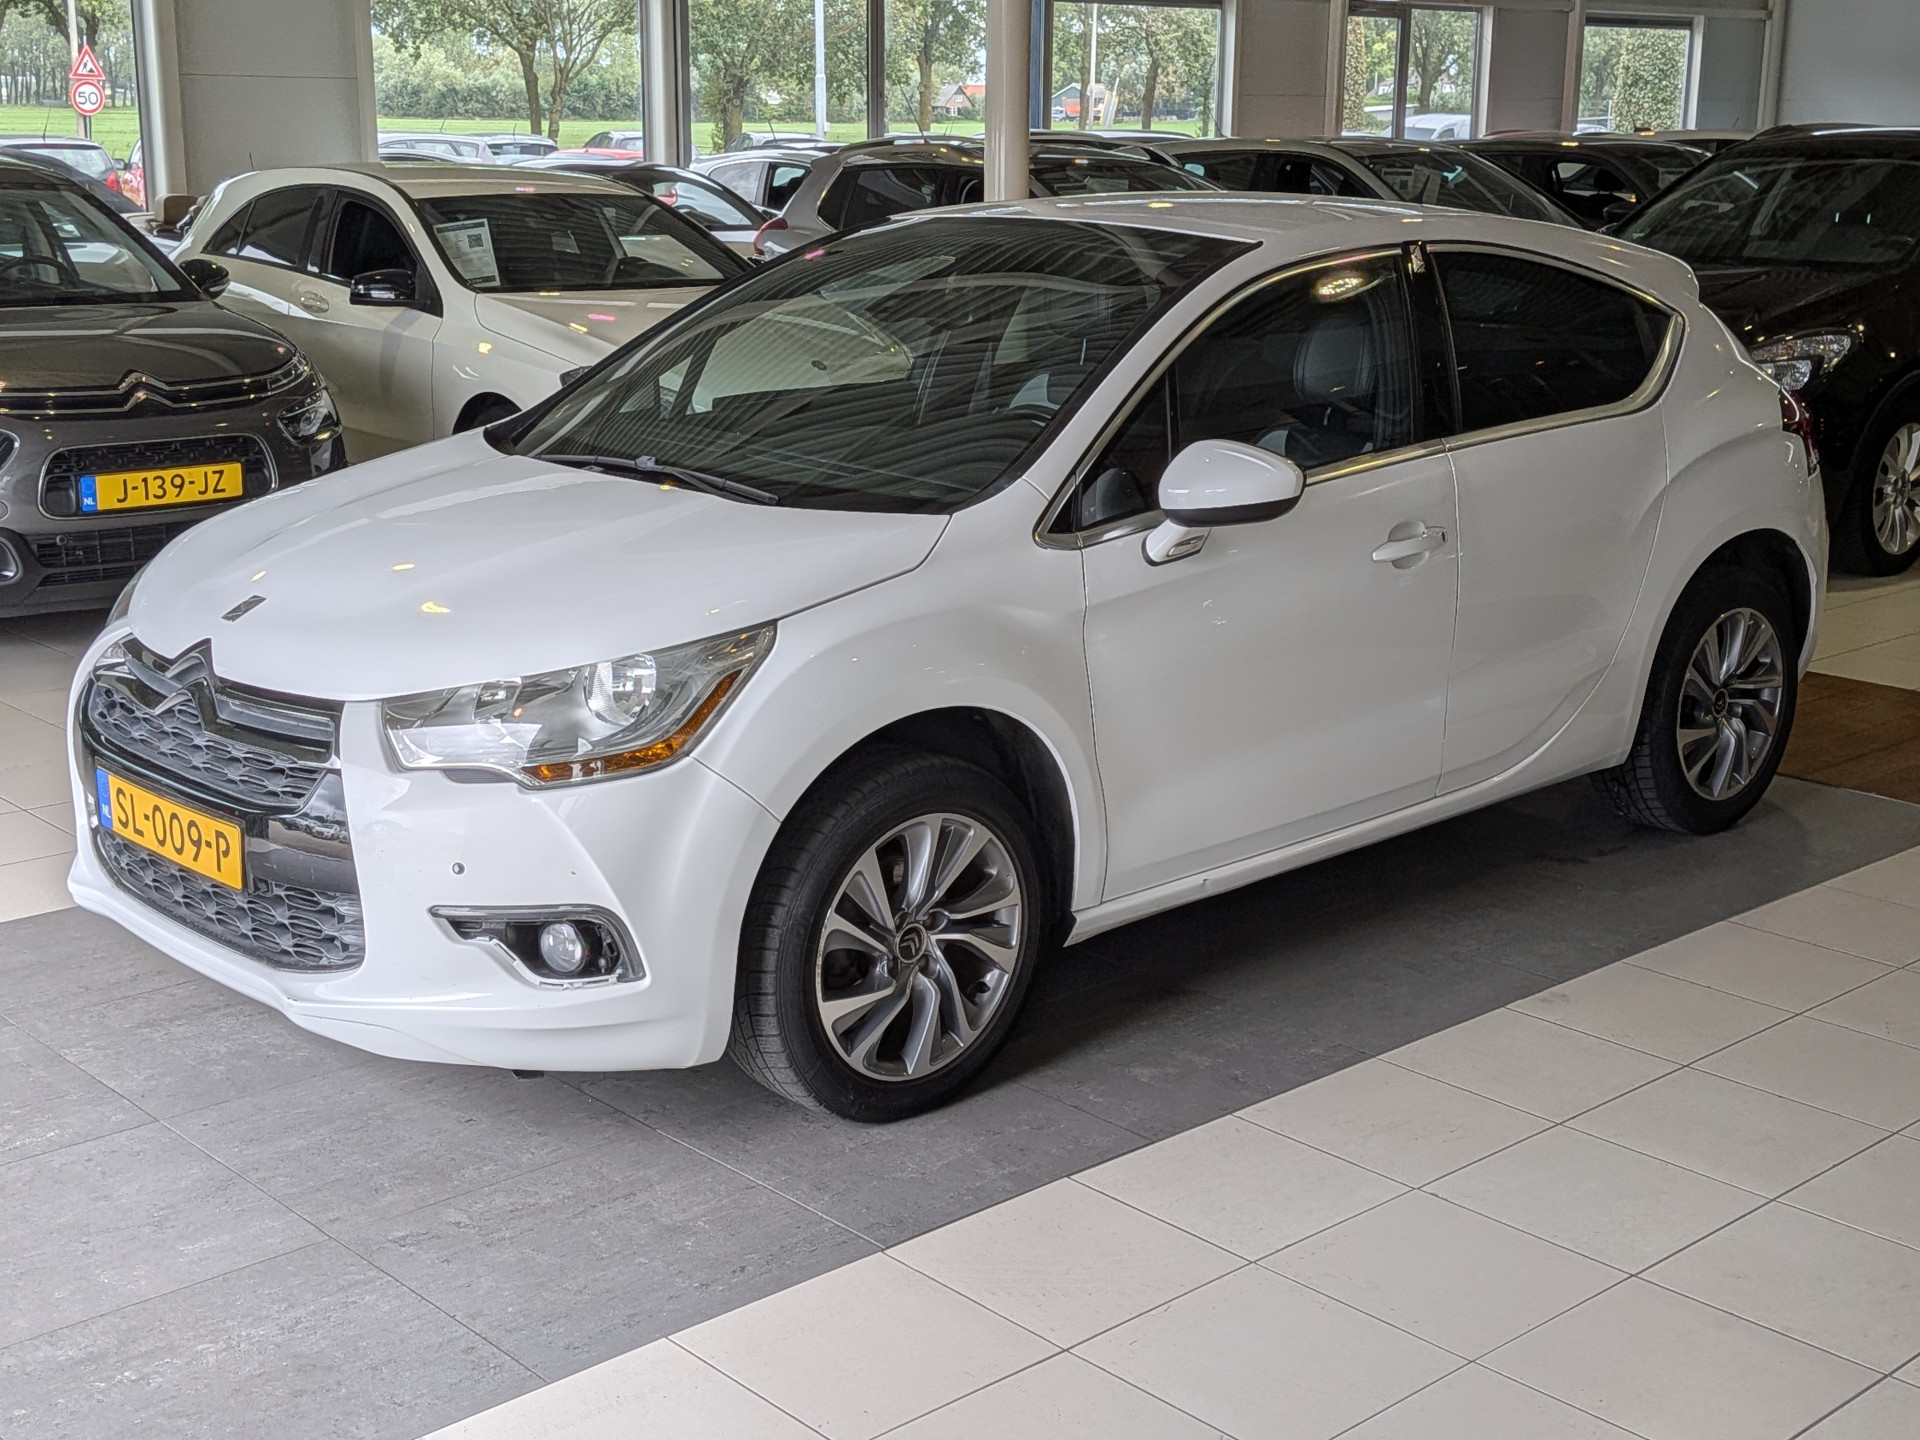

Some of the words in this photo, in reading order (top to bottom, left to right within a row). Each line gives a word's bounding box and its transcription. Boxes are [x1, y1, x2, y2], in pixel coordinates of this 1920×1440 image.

[78, 91, 98, 105] 50
[116, 469, 226, 504] J-139-JZ
[83, 497, 96, 506] NL
[101, 803, 111, 819] NL
[115, 787, 231, 873] SL-009-P
